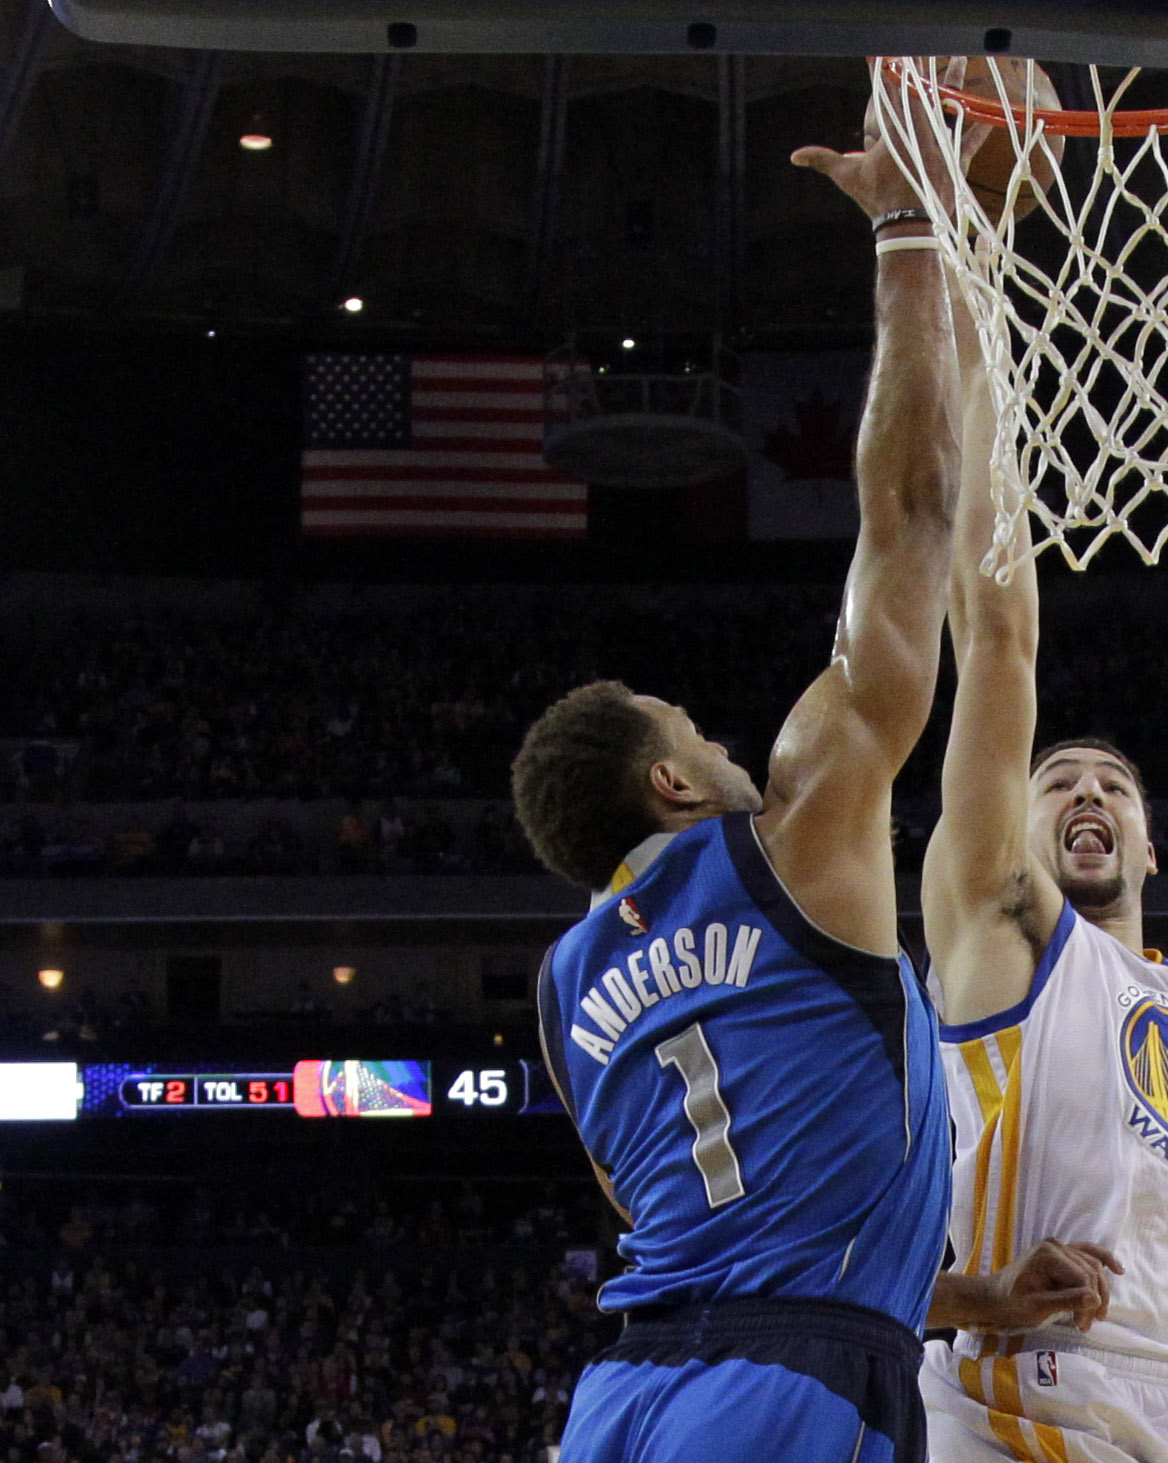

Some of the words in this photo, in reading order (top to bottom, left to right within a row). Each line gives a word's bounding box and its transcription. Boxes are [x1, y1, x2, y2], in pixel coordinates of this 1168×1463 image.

[570, 922, 762, 1065] ANDERSON
[138, 1082, 164, 1102] TF
[165, 1080, 186, 1103] 2
[204, 1082, 242, 1102] TOL
[447, 1069, 508, 1106] 45
[655, 1021, 745, 1209] 1
